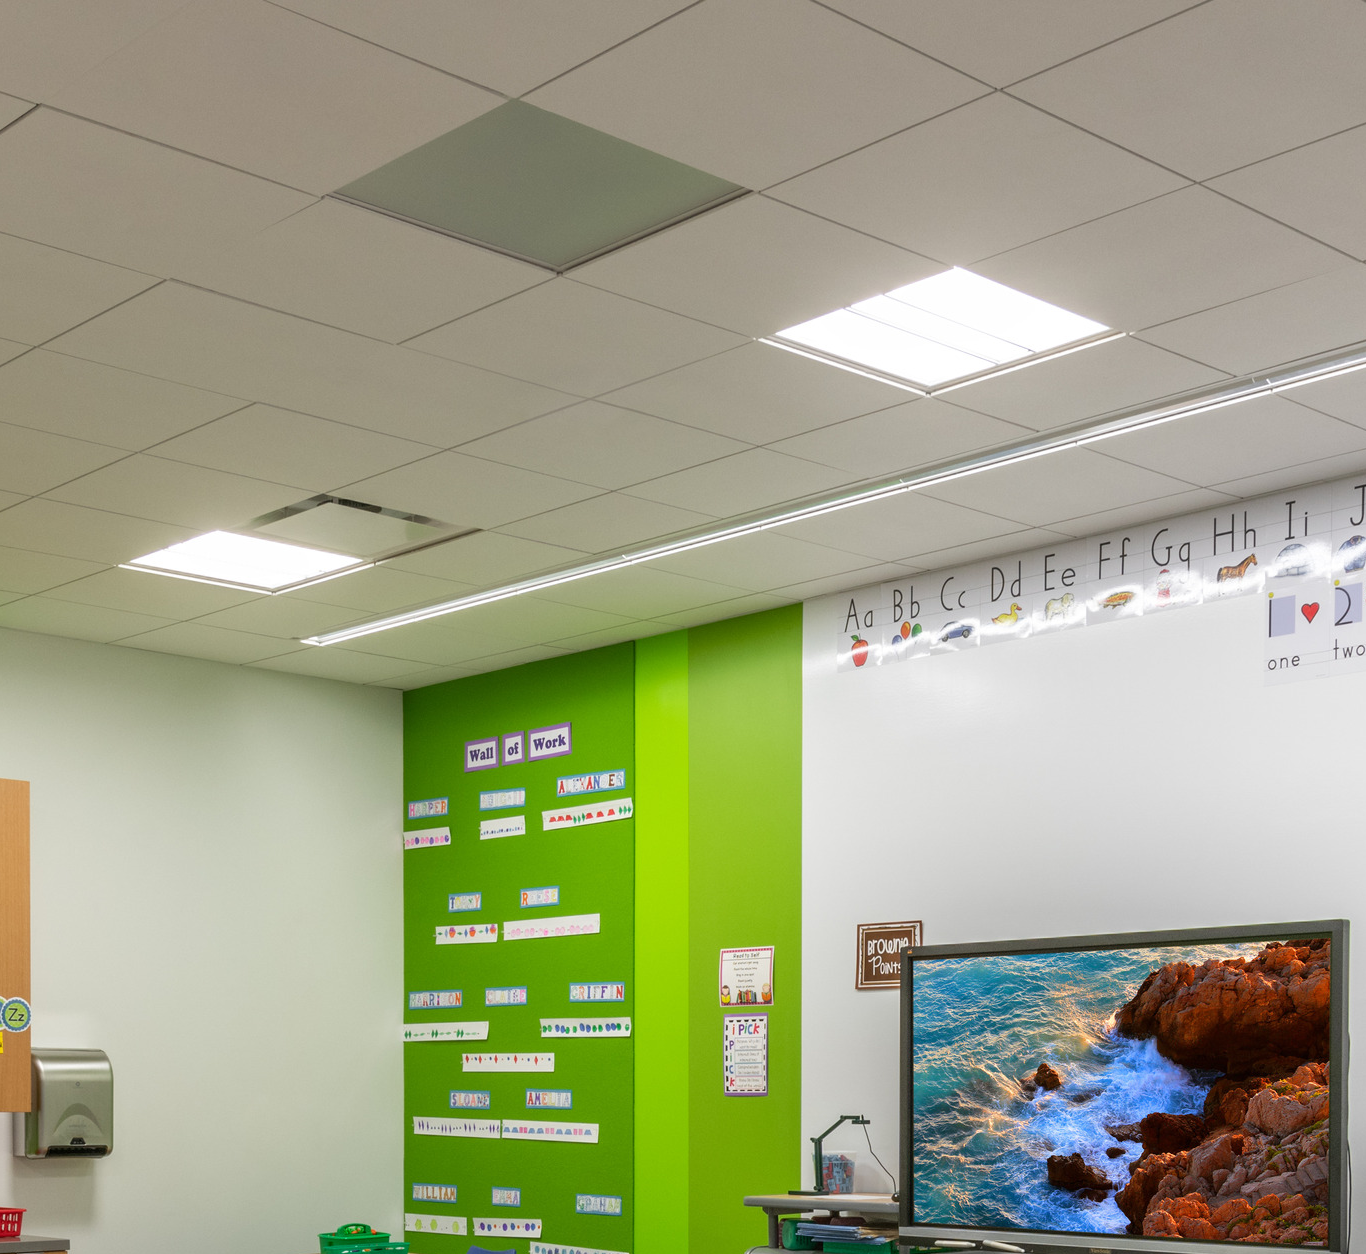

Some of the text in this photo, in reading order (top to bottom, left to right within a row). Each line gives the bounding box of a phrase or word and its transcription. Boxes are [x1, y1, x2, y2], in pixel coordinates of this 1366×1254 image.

[1213, 510, 1257, 556] Hh
[1044, 553, 1076, 592] Ee
[844, 598, 873, 633] Aa
[1267, 652, 1301, 671] one
[1333, 638, 1366, 660] two
[470, 734, 566, 762] Wall of Work
